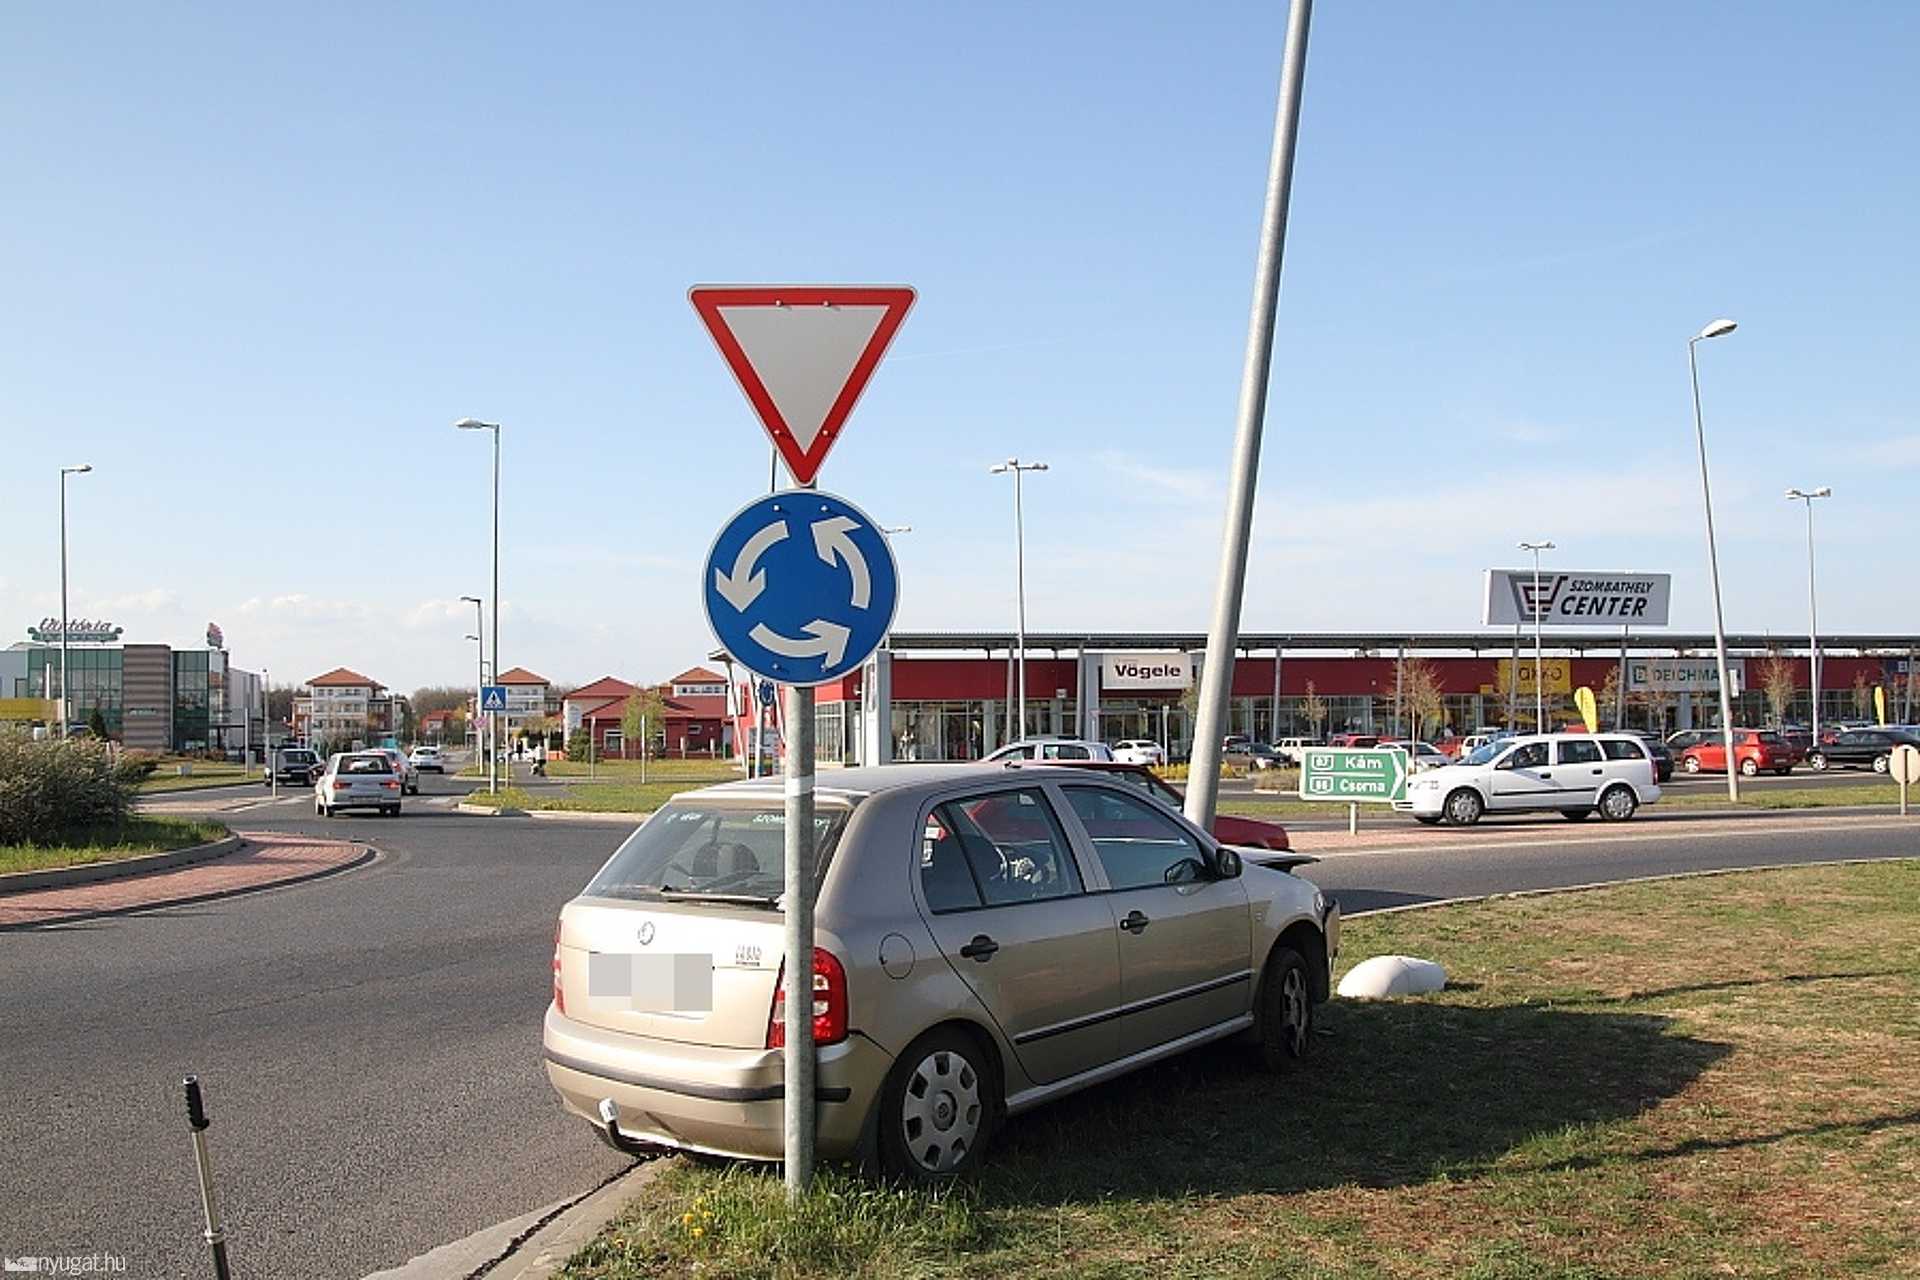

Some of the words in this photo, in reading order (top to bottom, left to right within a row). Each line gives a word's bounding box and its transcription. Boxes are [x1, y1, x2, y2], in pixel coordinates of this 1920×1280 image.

[1569, 579, 1654, 593] SZOMBATHELY
[1560, 595, 1648, 617] CENTER
[1114, 663, 1181, 679] Vögele
[1345, 755, 1384, 769] Kám
[1340, 778, 1386, 792] Csorna
